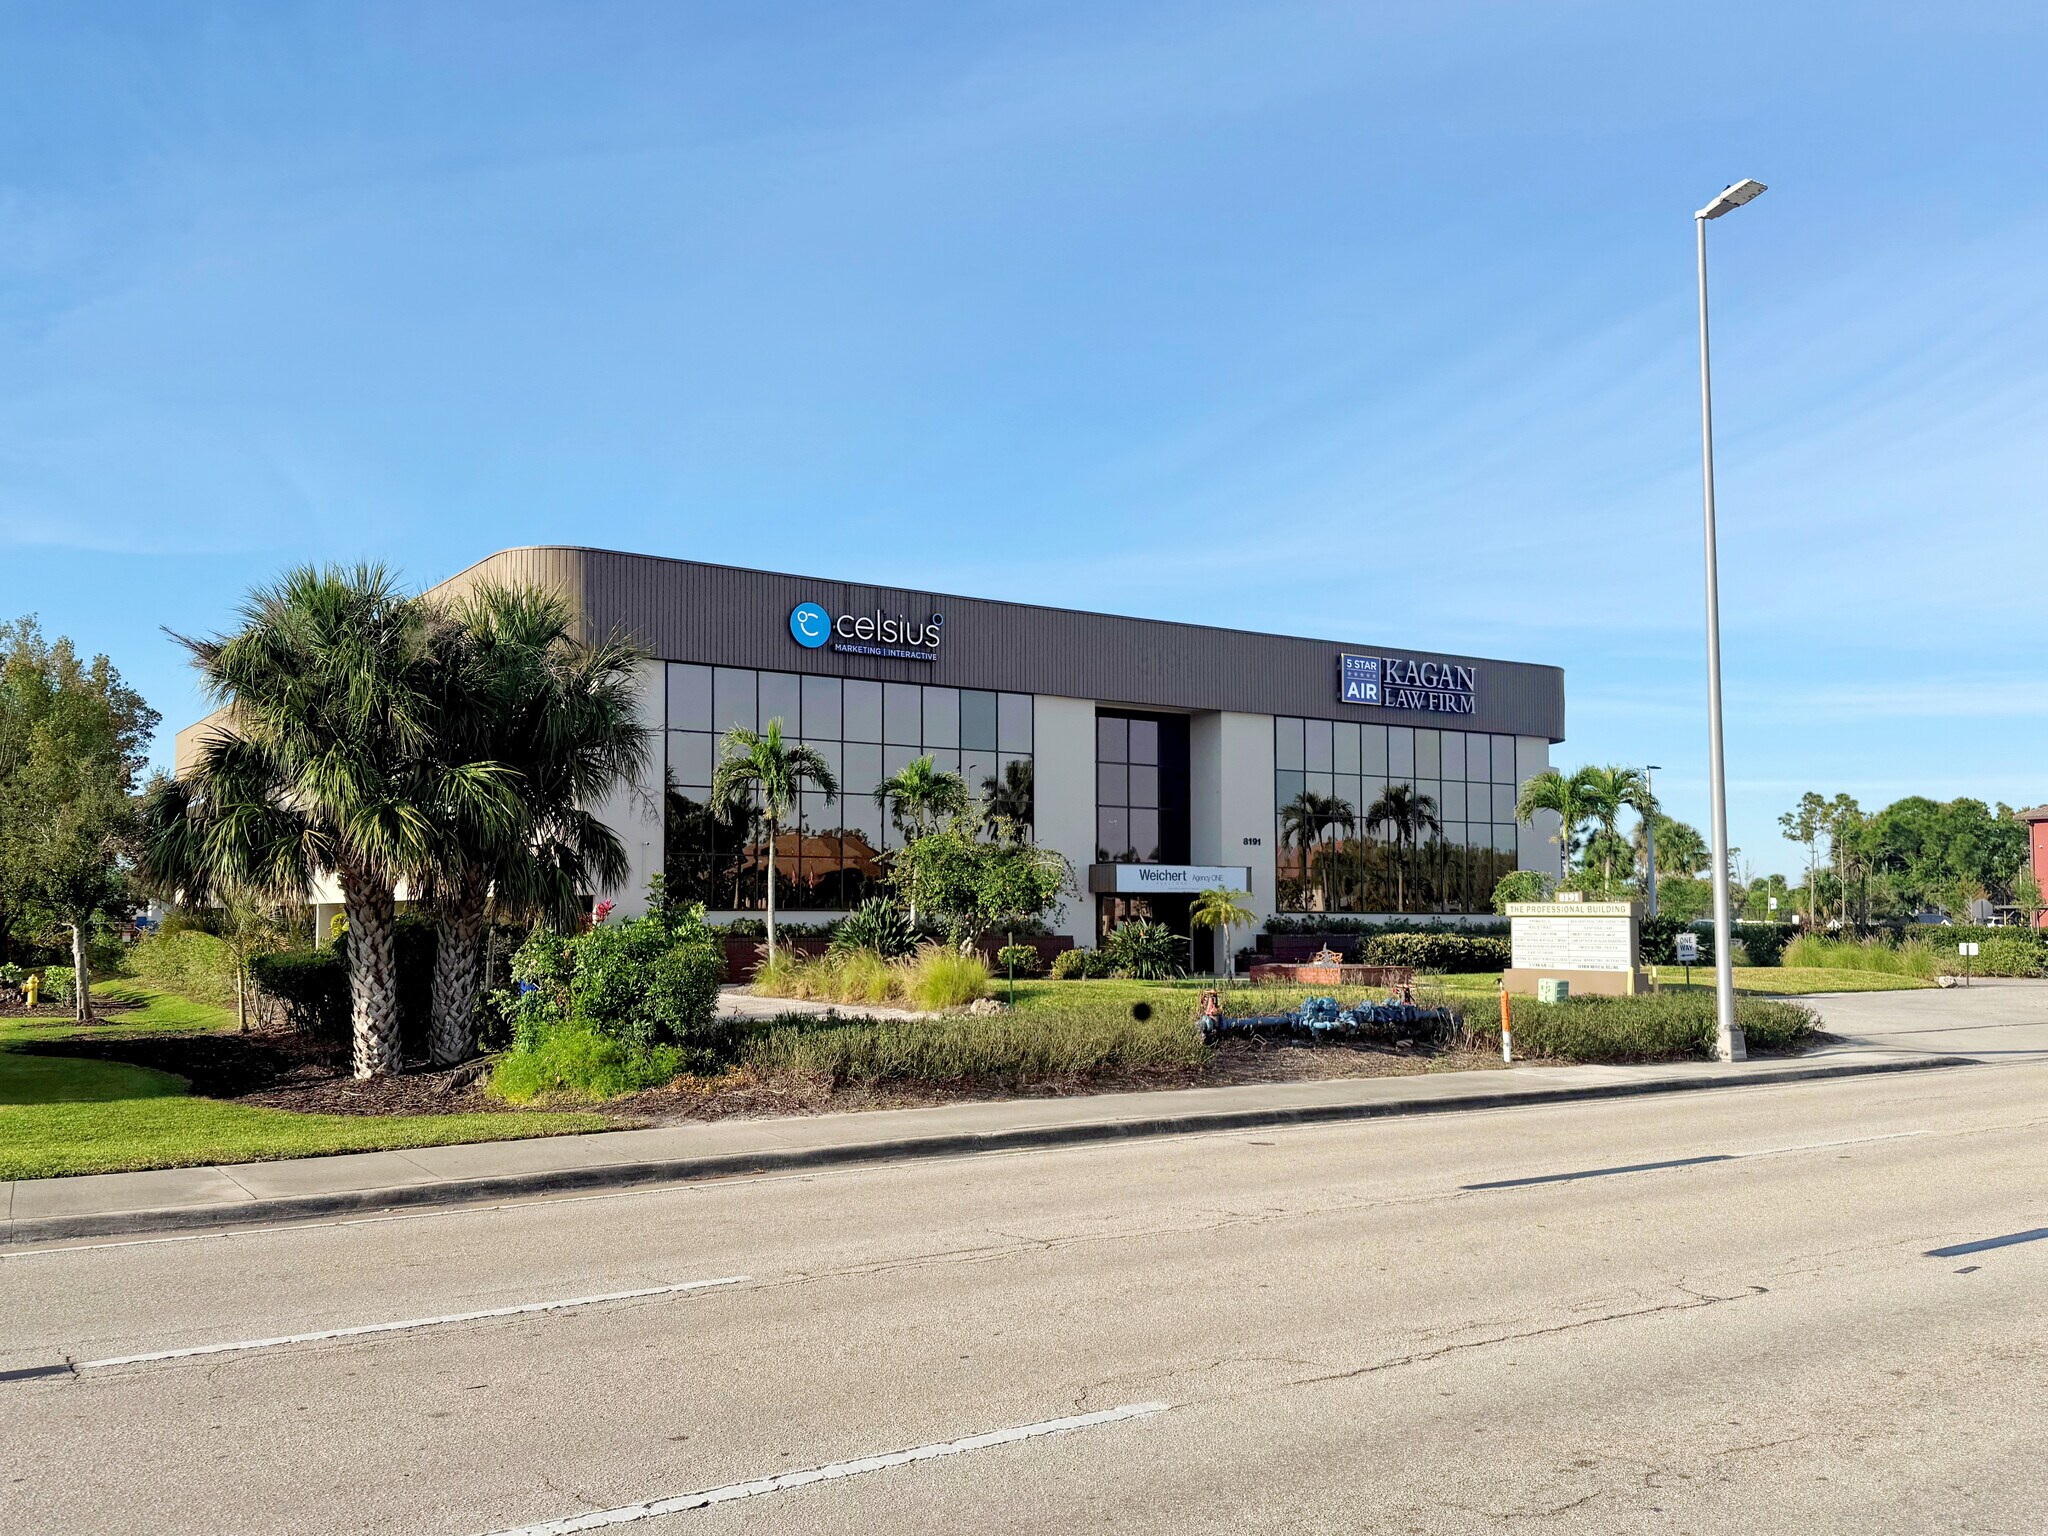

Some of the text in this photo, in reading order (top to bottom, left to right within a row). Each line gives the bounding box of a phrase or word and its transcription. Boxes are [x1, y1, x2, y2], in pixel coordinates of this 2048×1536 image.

[835, 643, 881, 656] MARKETING
[888, 649, 938, 661] INTERACTIVE
[1347, 659, 1377, 670] 5 STAR
[1382, 658, 1476, 691] KAGAN
[1347, 682, 1377, 700] AIR
[1384, 688, 1476, 714] LAW FIRM
[1243, 837, 1261, 846] 8191
[1139, 869, 1187, 881] Weichert
[1211, 874, 1224, 882] ONE
[1559, 893, 1579, 902] 8191
[1527, 906, 1585, 914] PROFESSIONAL
[1587, 906, 1626, 914] BUILDING
